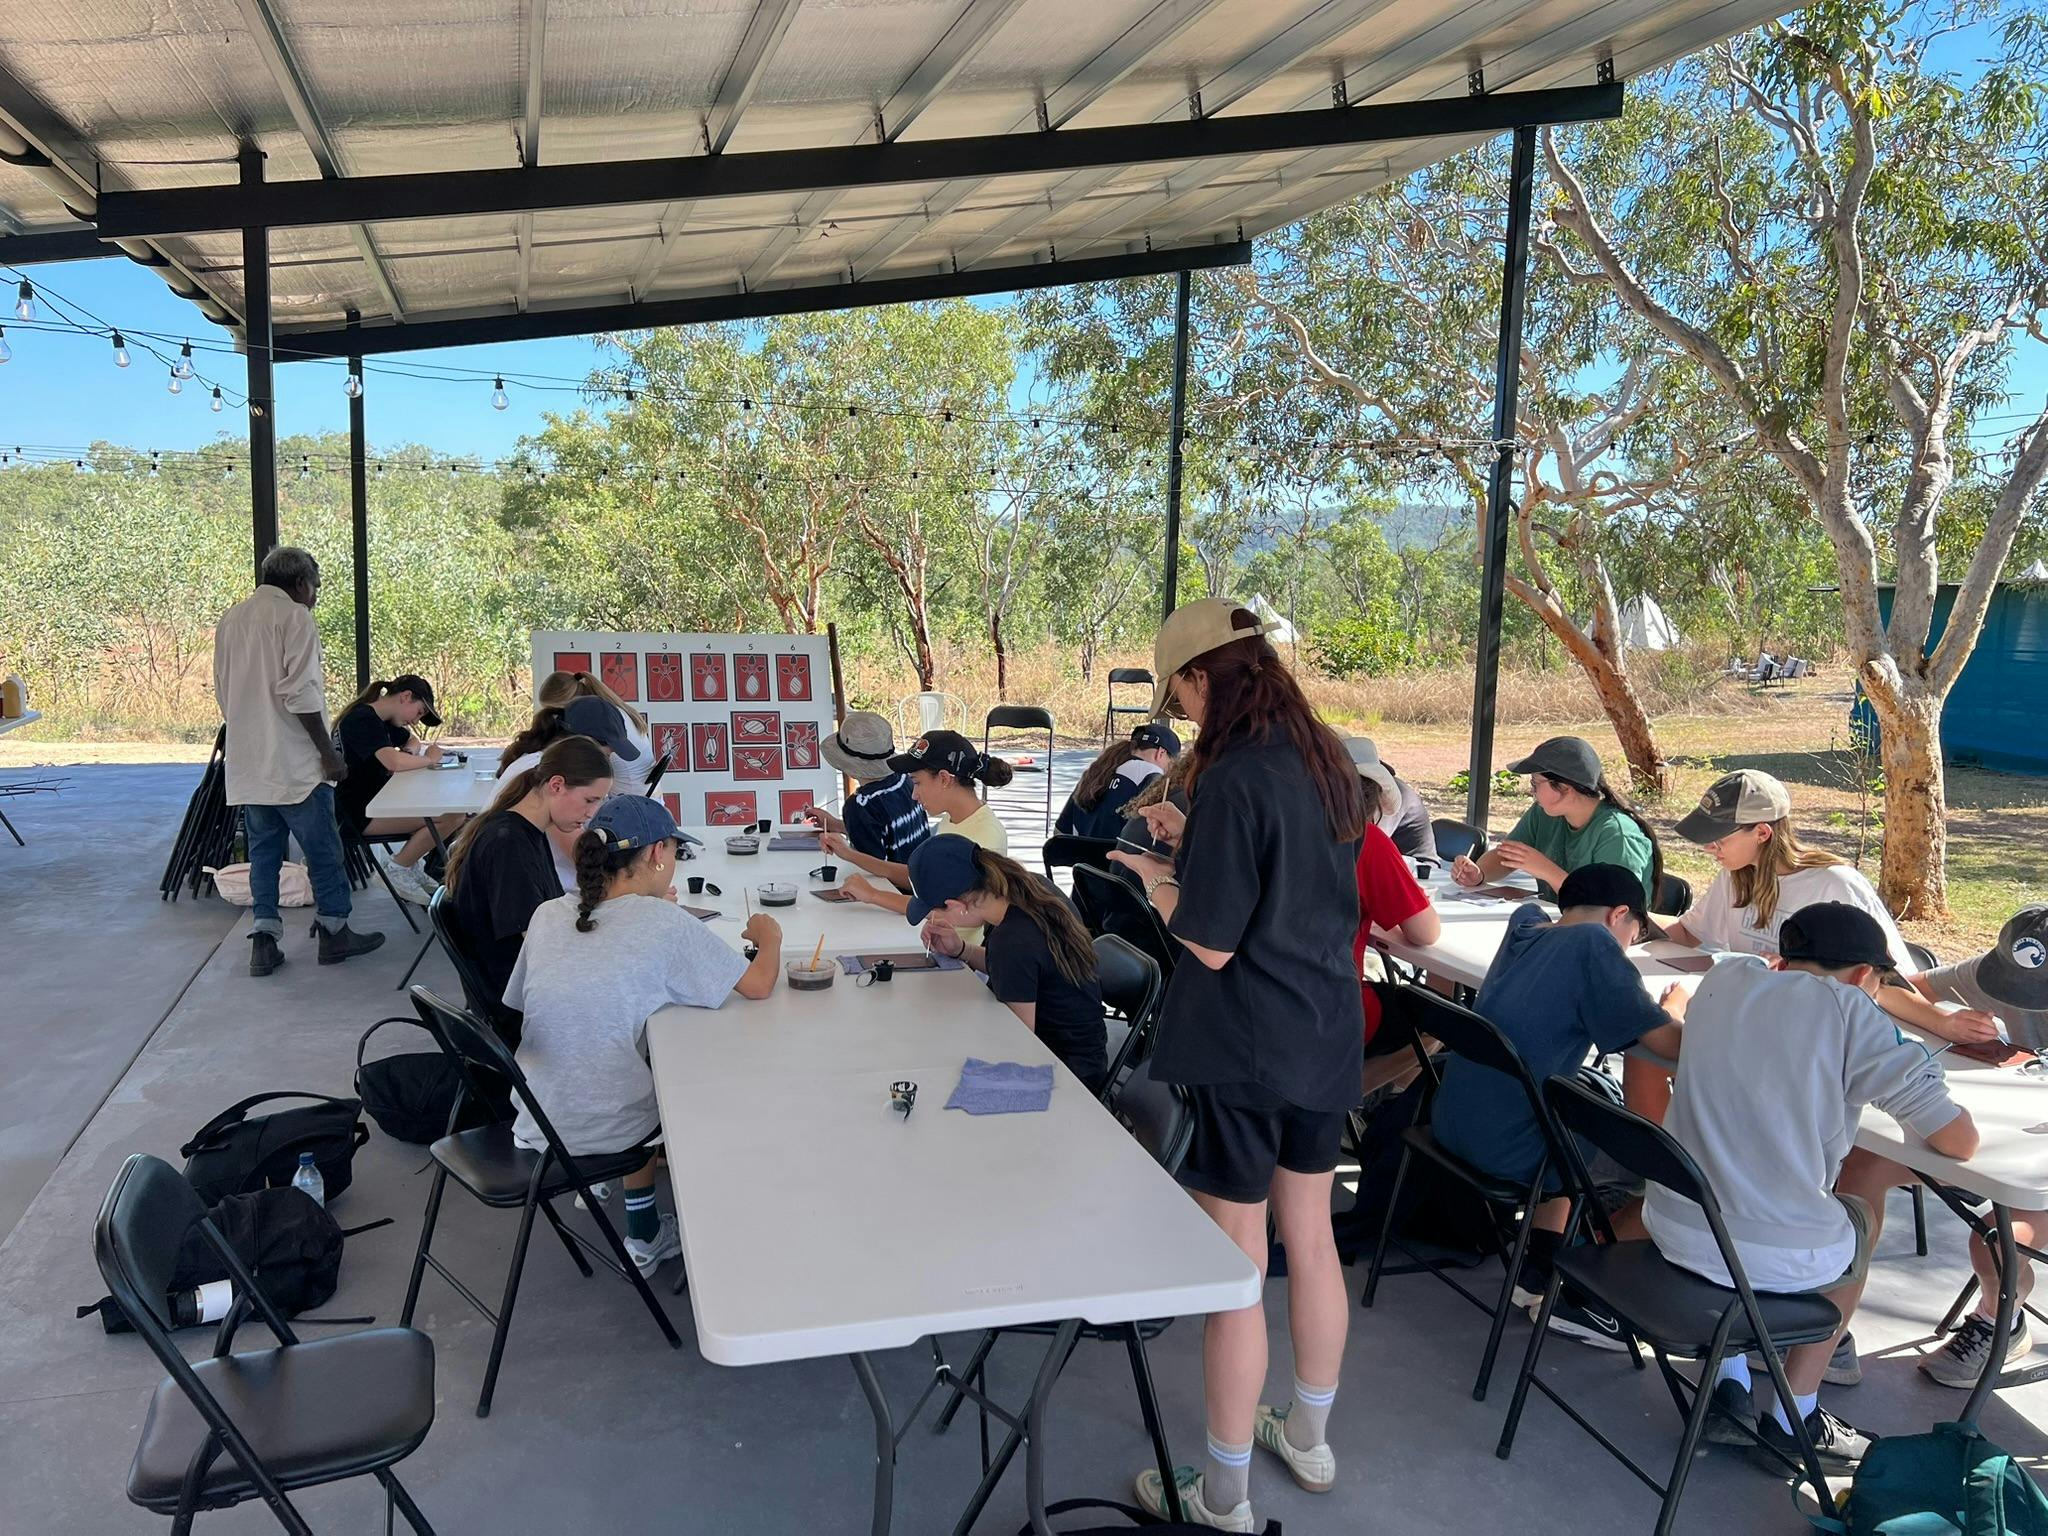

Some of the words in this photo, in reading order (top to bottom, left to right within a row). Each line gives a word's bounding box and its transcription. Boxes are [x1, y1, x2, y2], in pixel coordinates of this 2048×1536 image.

[569, 641, 575, 649] 1
[615, 641, 622, 650] 2
[662, 642, 668, 650] 3
[748, 643, 754, 651] 5
[790, 643, 796, 652] 6
